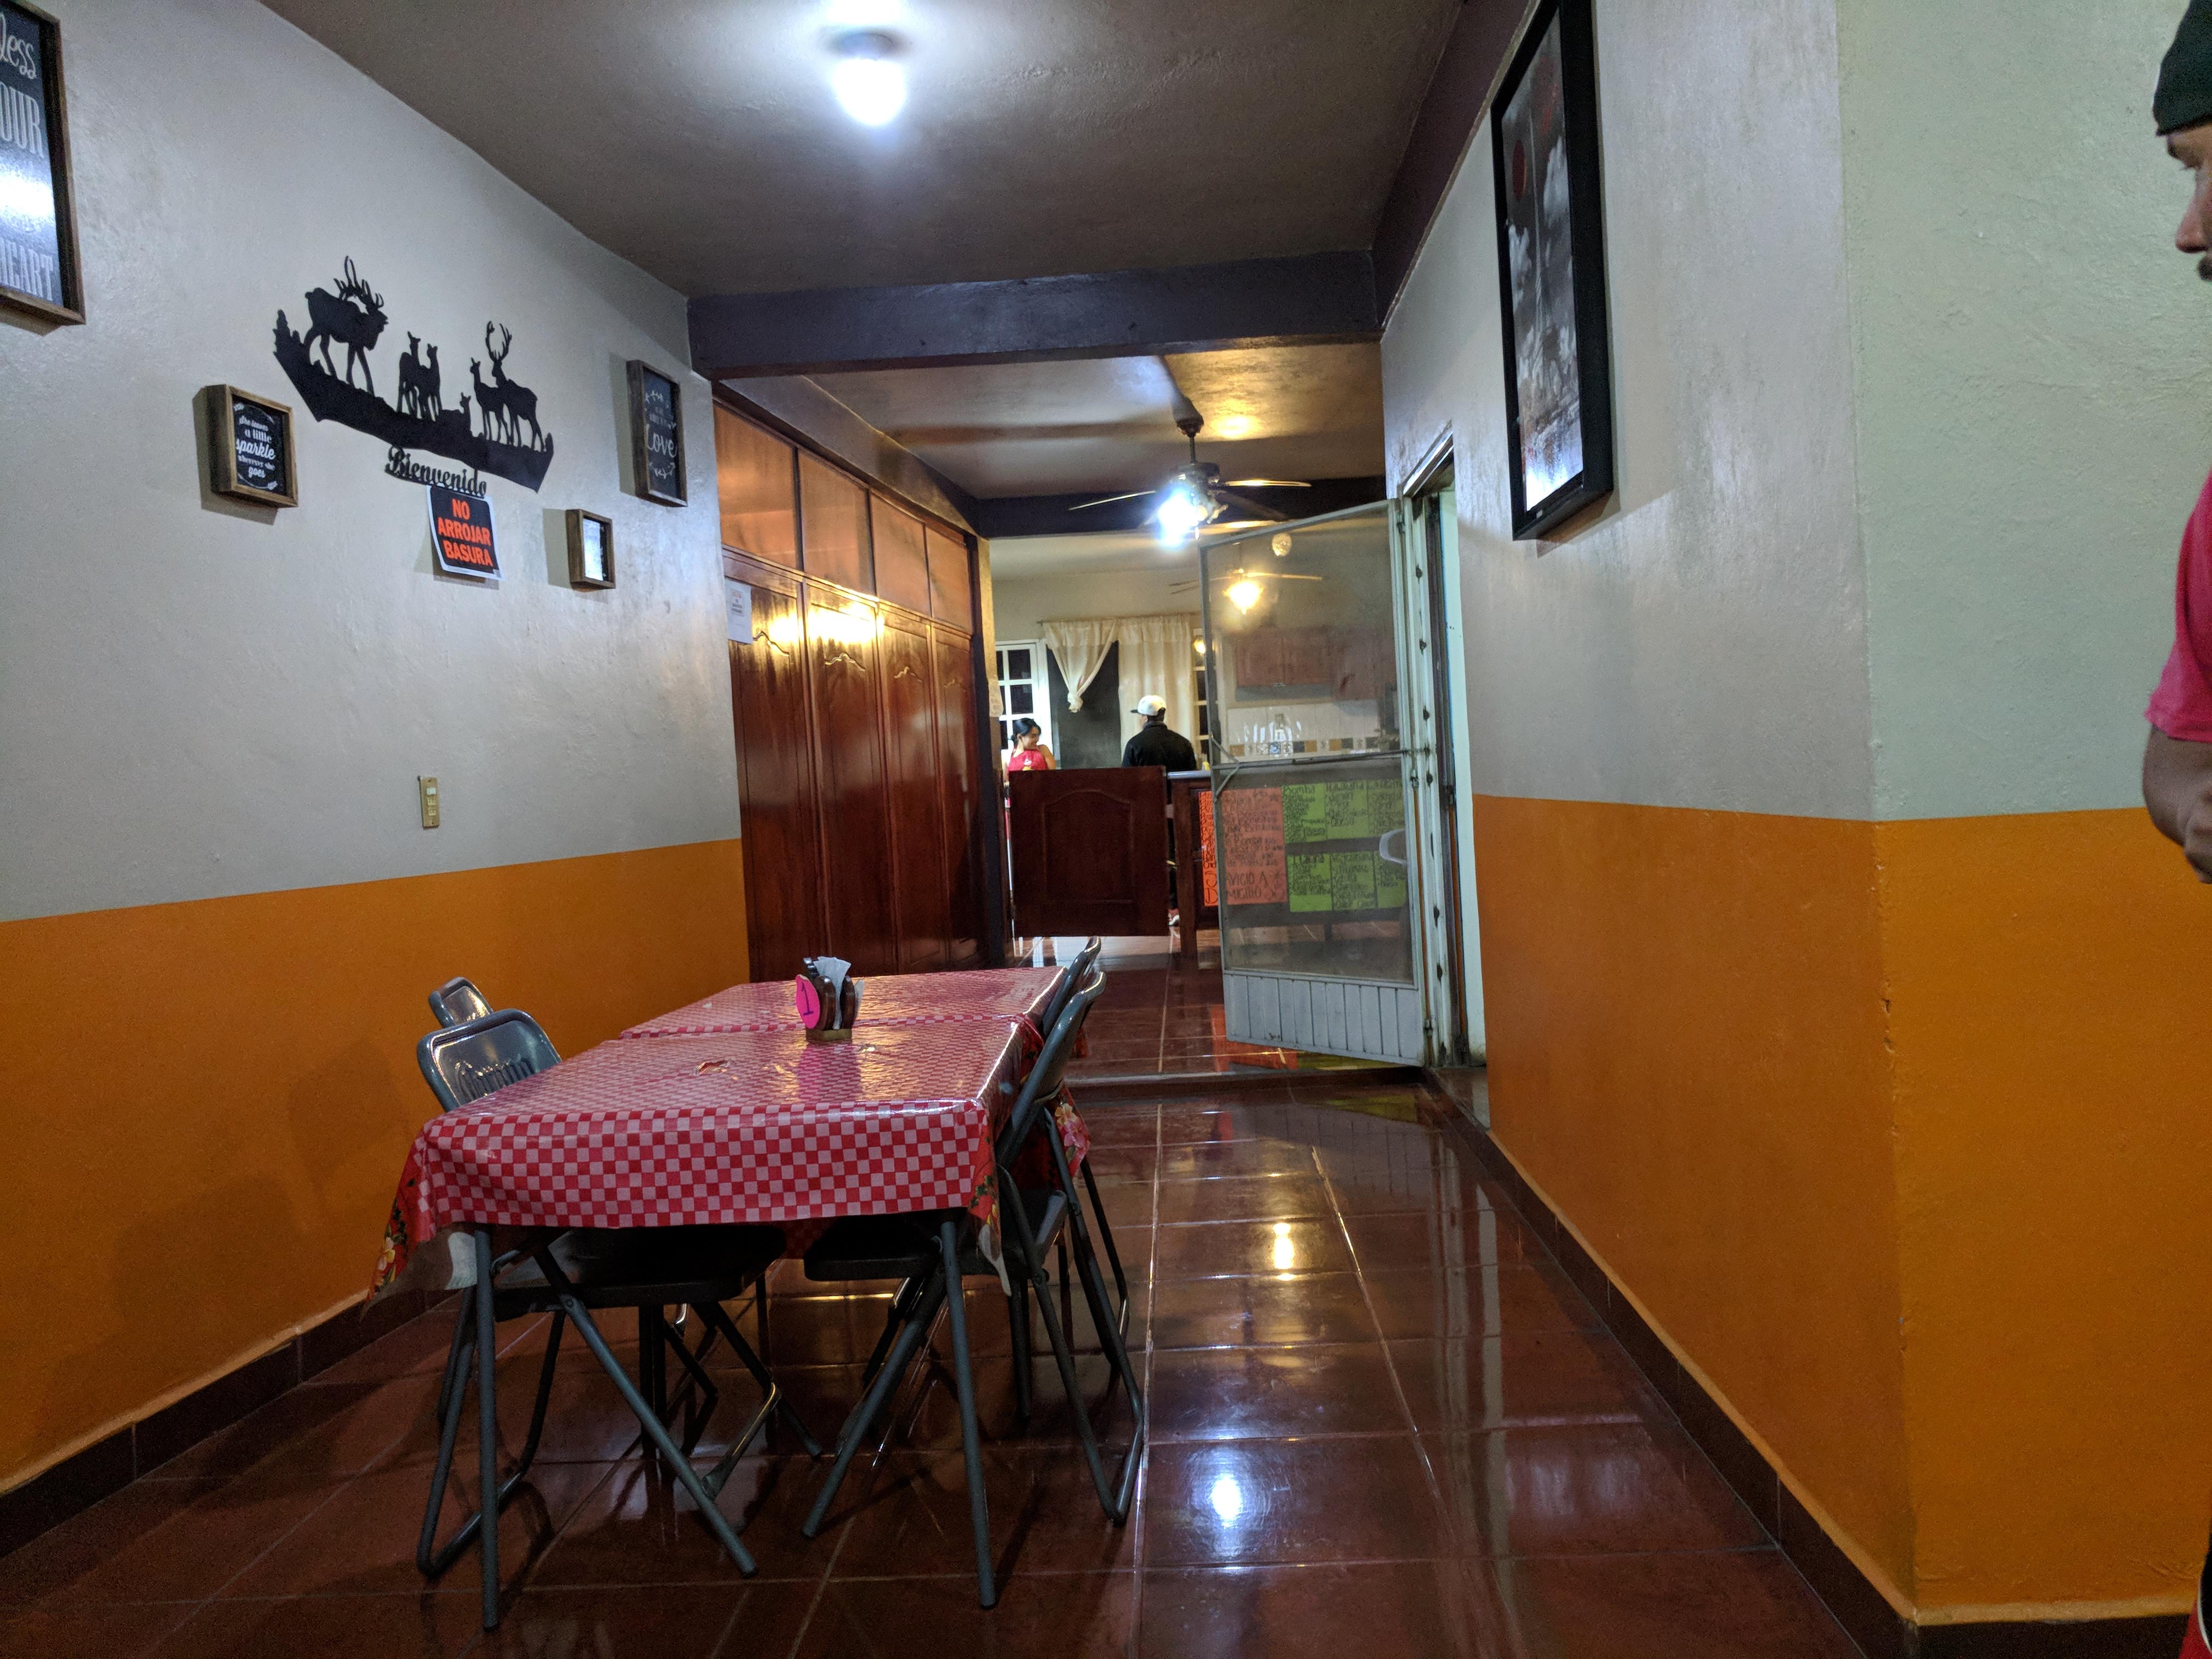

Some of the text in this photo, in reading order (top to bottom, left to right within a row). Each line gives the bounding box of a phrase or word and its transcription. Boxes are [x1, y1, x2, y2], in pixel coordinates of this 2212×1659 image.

[236, 438, 275, 461] sparkle
[248, 466, 266, 479] goes
[385, 445, 487, 498] Bienvenido
[451, 498, 471, 520] NO
[437, 517, 492, 546] ARROJAR
[442, 540, 493, 567] BASURA
[801, 981, 814, 1016] 1
